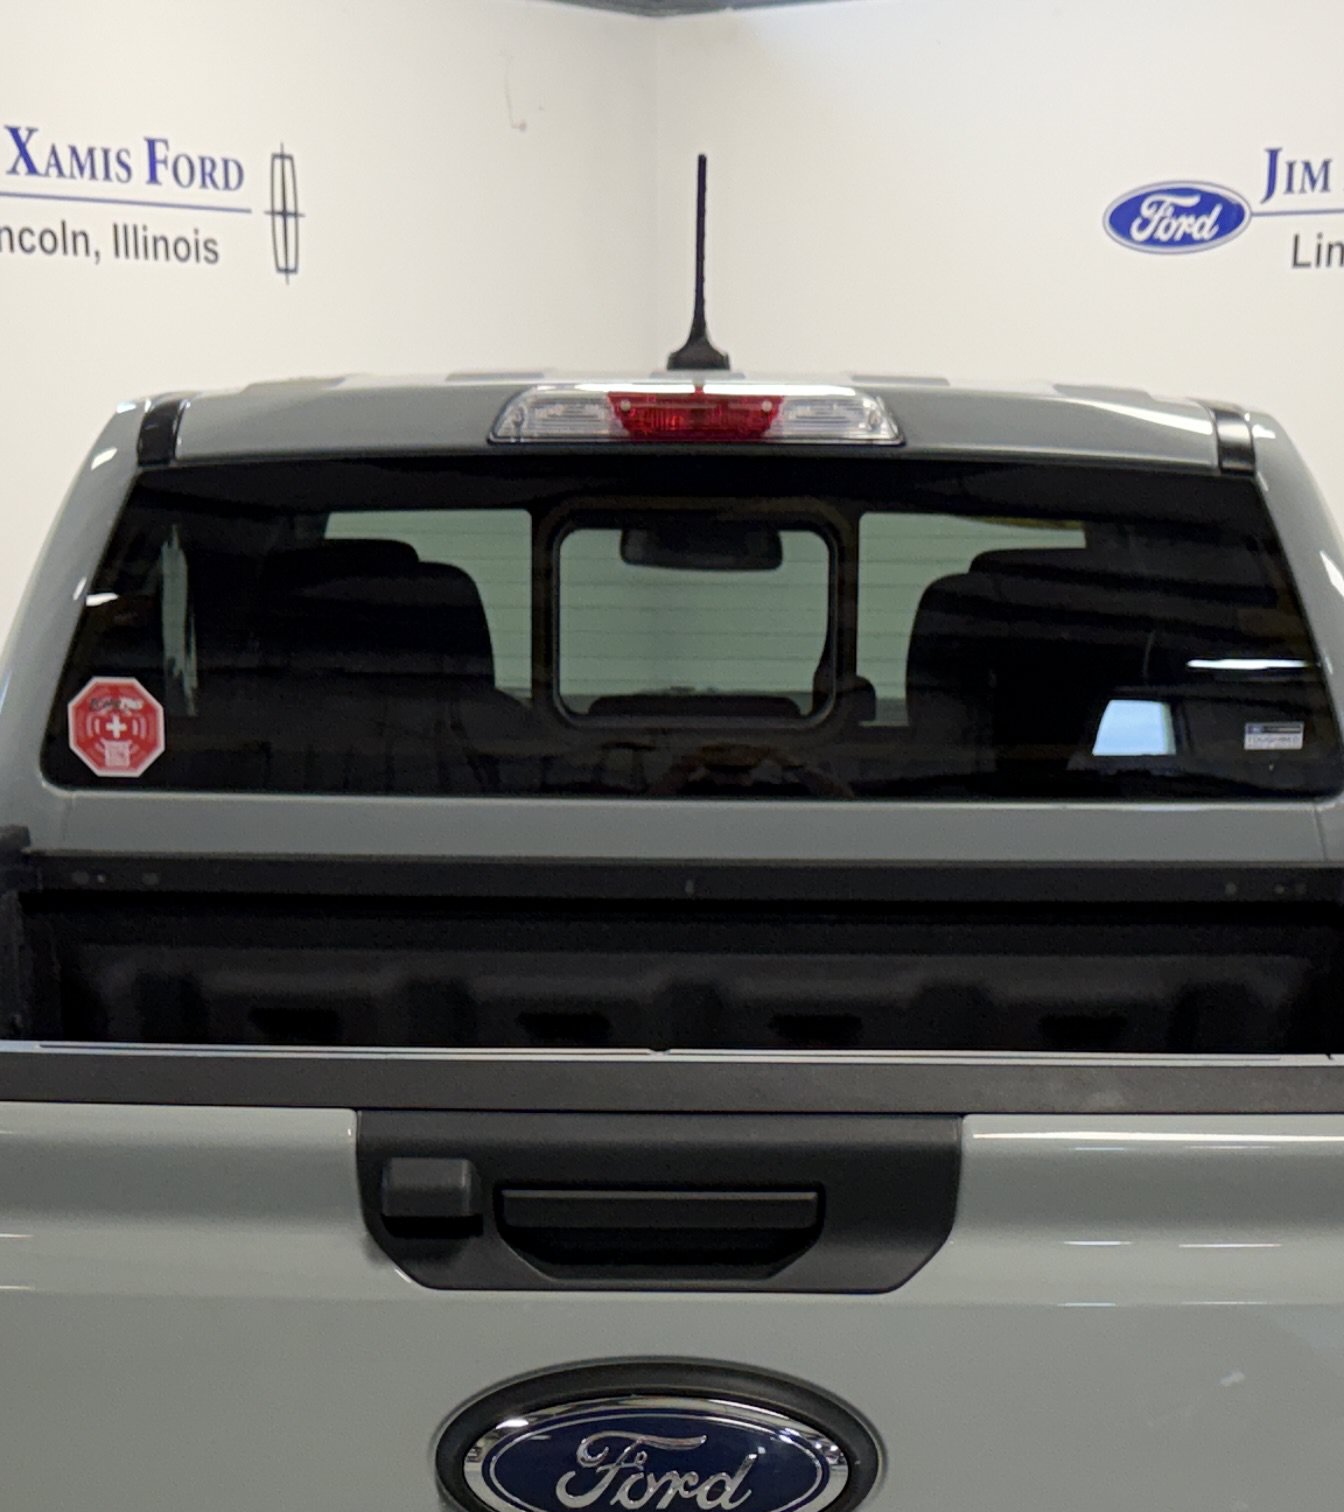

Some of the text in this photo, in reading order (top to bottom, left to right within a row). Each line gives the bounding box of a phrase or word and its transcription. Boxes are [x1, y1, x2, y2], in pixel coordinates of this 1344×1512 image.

[4, 125, 133, 184] XAMIS
[144, 136, 244, 192] FORD
[1260, 147, 1333, 203] JIM
[112, 222, 220, 264] Illinois
[1130, 192, 1220, 243] Ford
[555, 1430, 759, 1511] Ford
